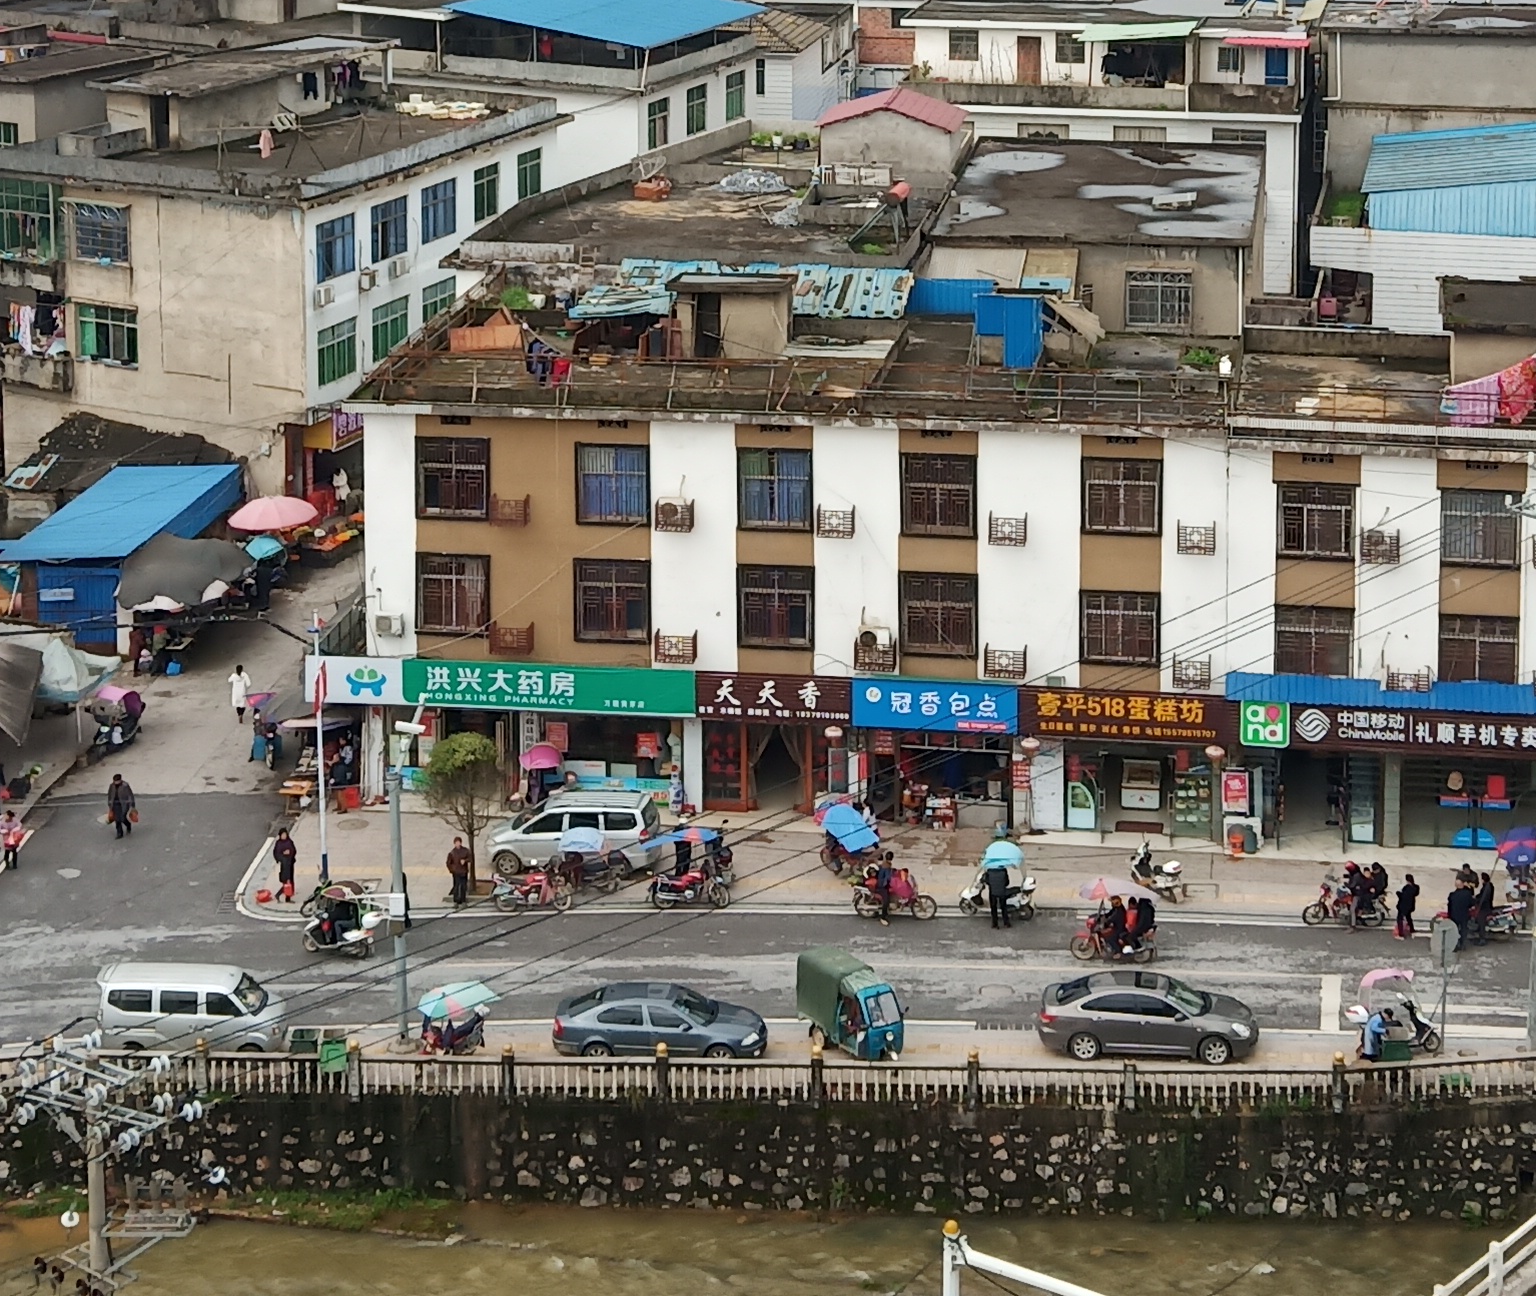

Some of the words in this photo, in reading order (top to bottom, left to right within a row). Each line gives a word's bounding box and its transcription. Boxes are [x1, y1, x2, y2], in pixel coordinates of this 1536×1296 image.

[426, 666, 575, 697] 洪兴大药房
[714, 679, 821, 710] 天天香
[504, 695, 574, 706] PHARMACY
[890, 691, 998, 718] 冠香包点
[1337, 710, 1405, 729] 中国移动
